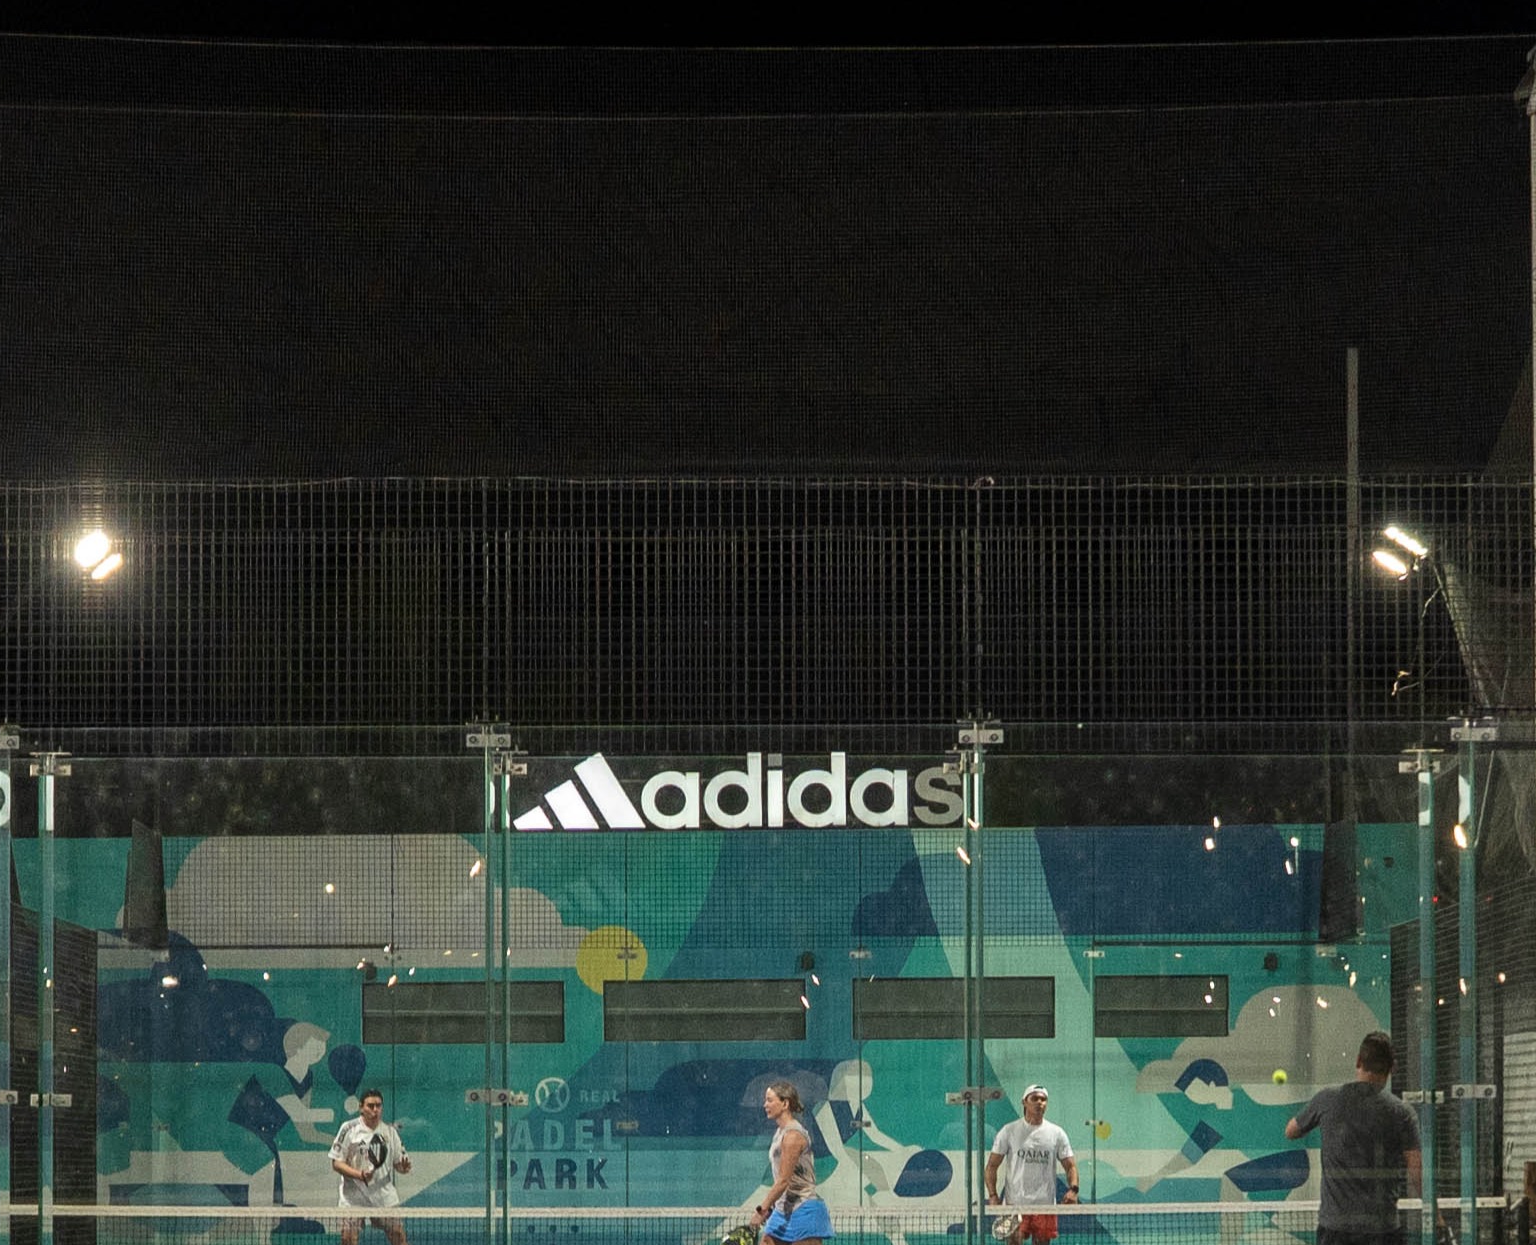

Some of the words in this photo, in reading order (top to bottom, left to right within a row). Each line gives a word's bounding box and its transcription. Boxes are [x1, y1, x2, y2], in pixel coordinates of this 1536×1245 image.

[641, 751, 964, 828] adidas
[579, 1089, 620, 1102] REAL
[497, 1158, 609, 1190] PARK
